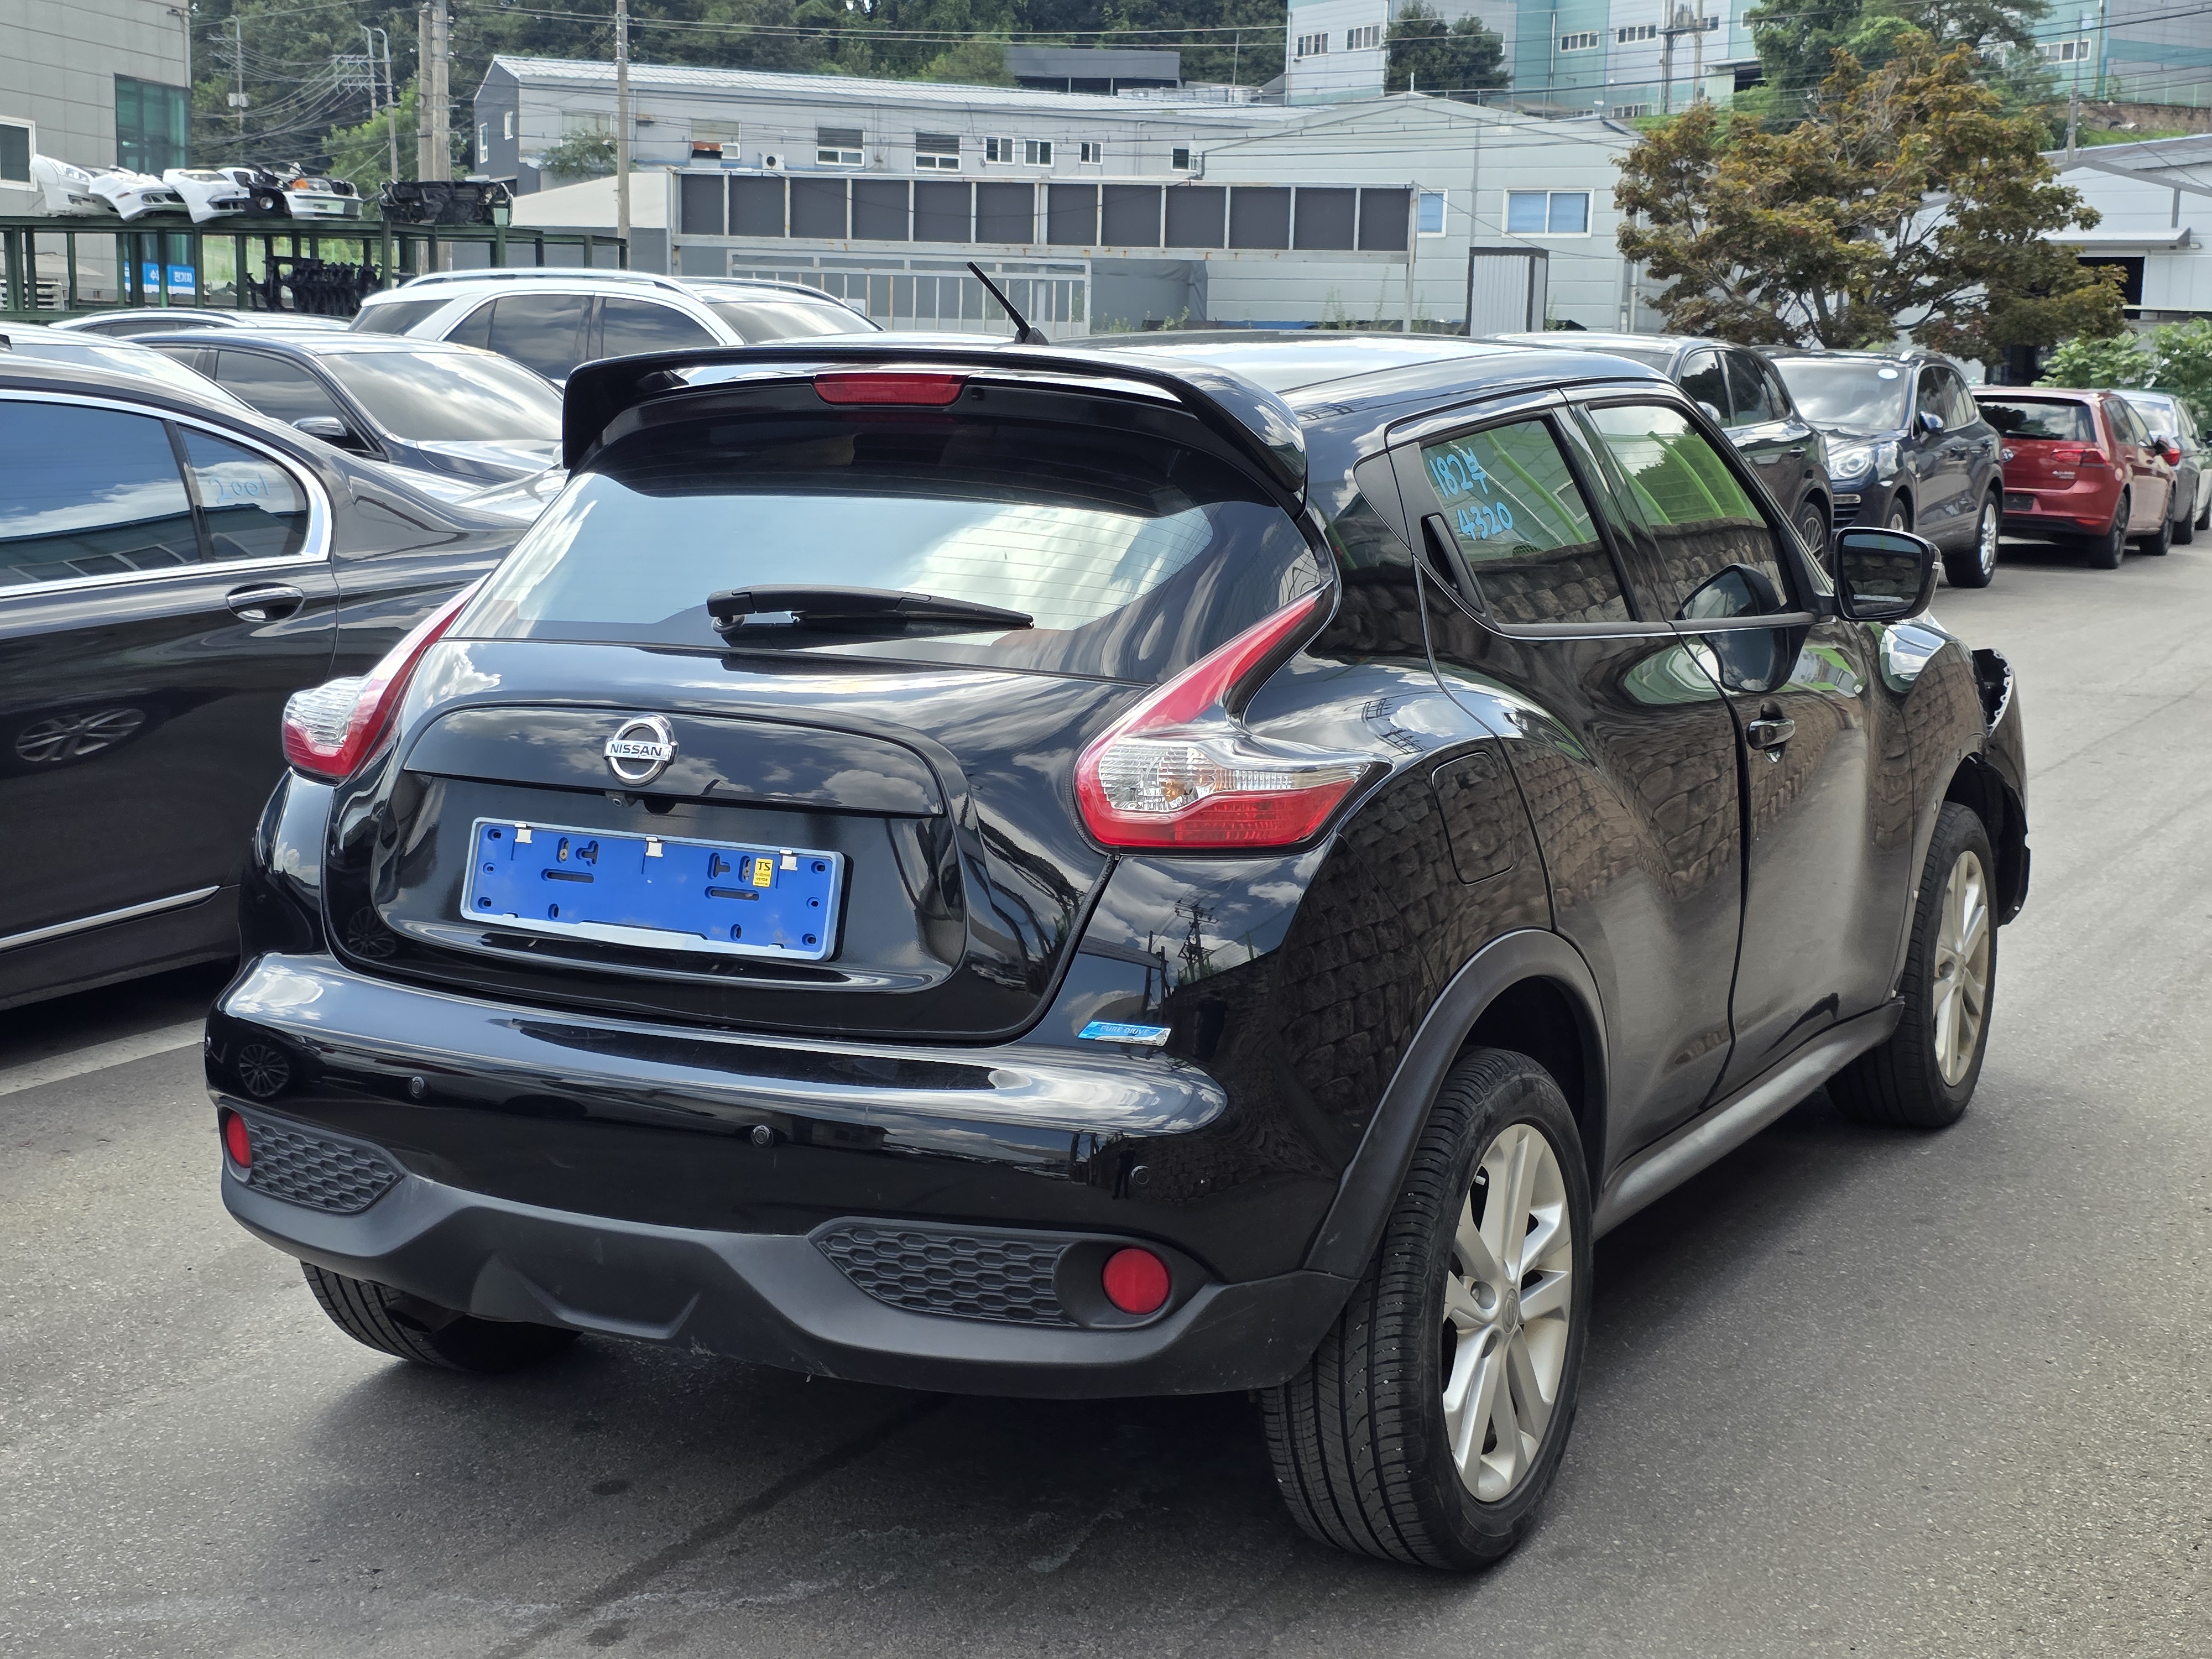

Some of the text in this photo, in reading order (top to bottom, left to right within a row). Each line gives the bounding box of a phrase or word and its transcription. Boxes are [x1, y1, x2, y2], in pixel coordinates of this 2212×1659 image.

[1429, 447, 1488, 498] 182부
[208, 473, 270, 504] 2001
[1457, 502, 1513, 540] 4320
[610, 744, 662, 757] NISSAN
[757, 861, 771, 871] TS
[1124, 1027, 1150, 1036] DRIVE
